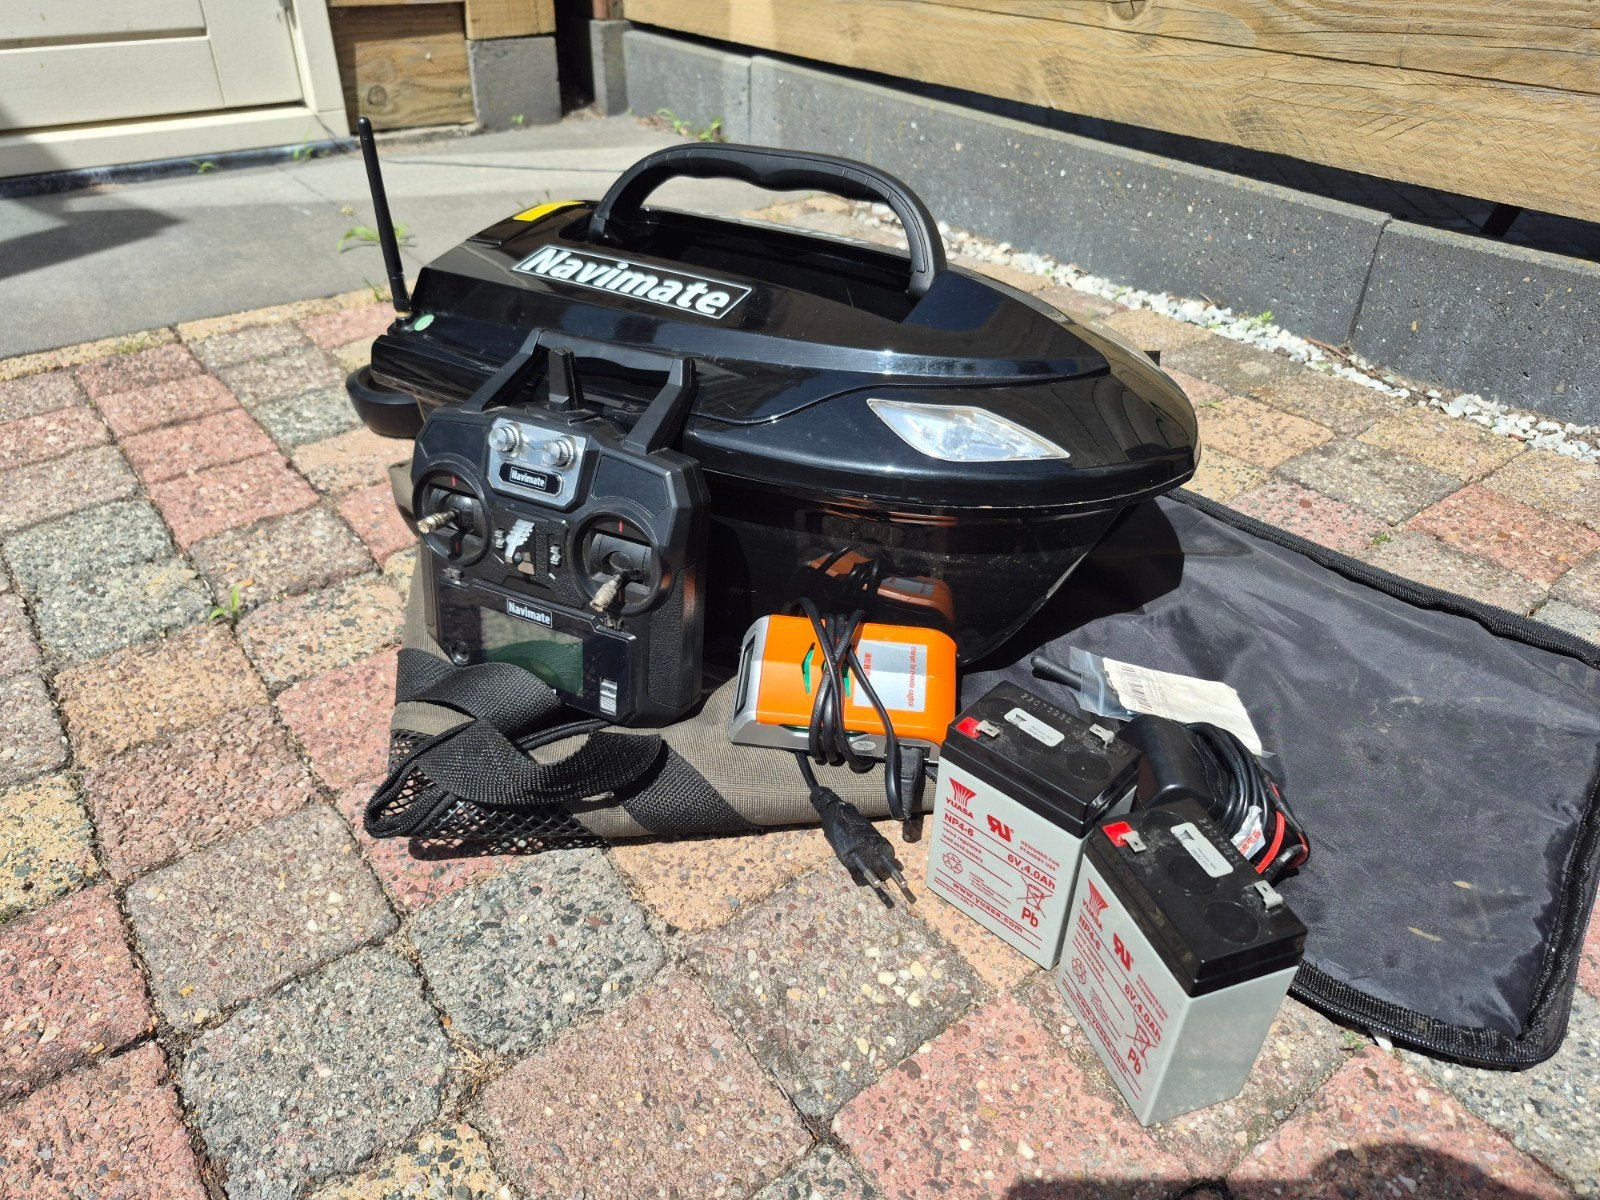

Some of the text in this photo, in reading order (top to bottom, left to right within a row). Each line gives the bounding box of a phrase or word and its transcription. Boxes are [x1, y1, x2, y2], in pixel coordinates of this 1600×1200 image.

[521, 249, 730, 315] Navimate
[511, 469, 545, 487] Navimate
[508, 601, 551, 625] Navimate
[946, 797, 974, 819] YUASA
[944, 812, 974, 837] NP4-6
[953, 882, 1022, 933] www.yuasa.com
[1021, 906, 1039, 928] Pb
[1083, 898, 1103, 932] YUASA
[1079, 915, 1100, 951] NP4-6
[1127, 1047, 1141, 1074] Pb
